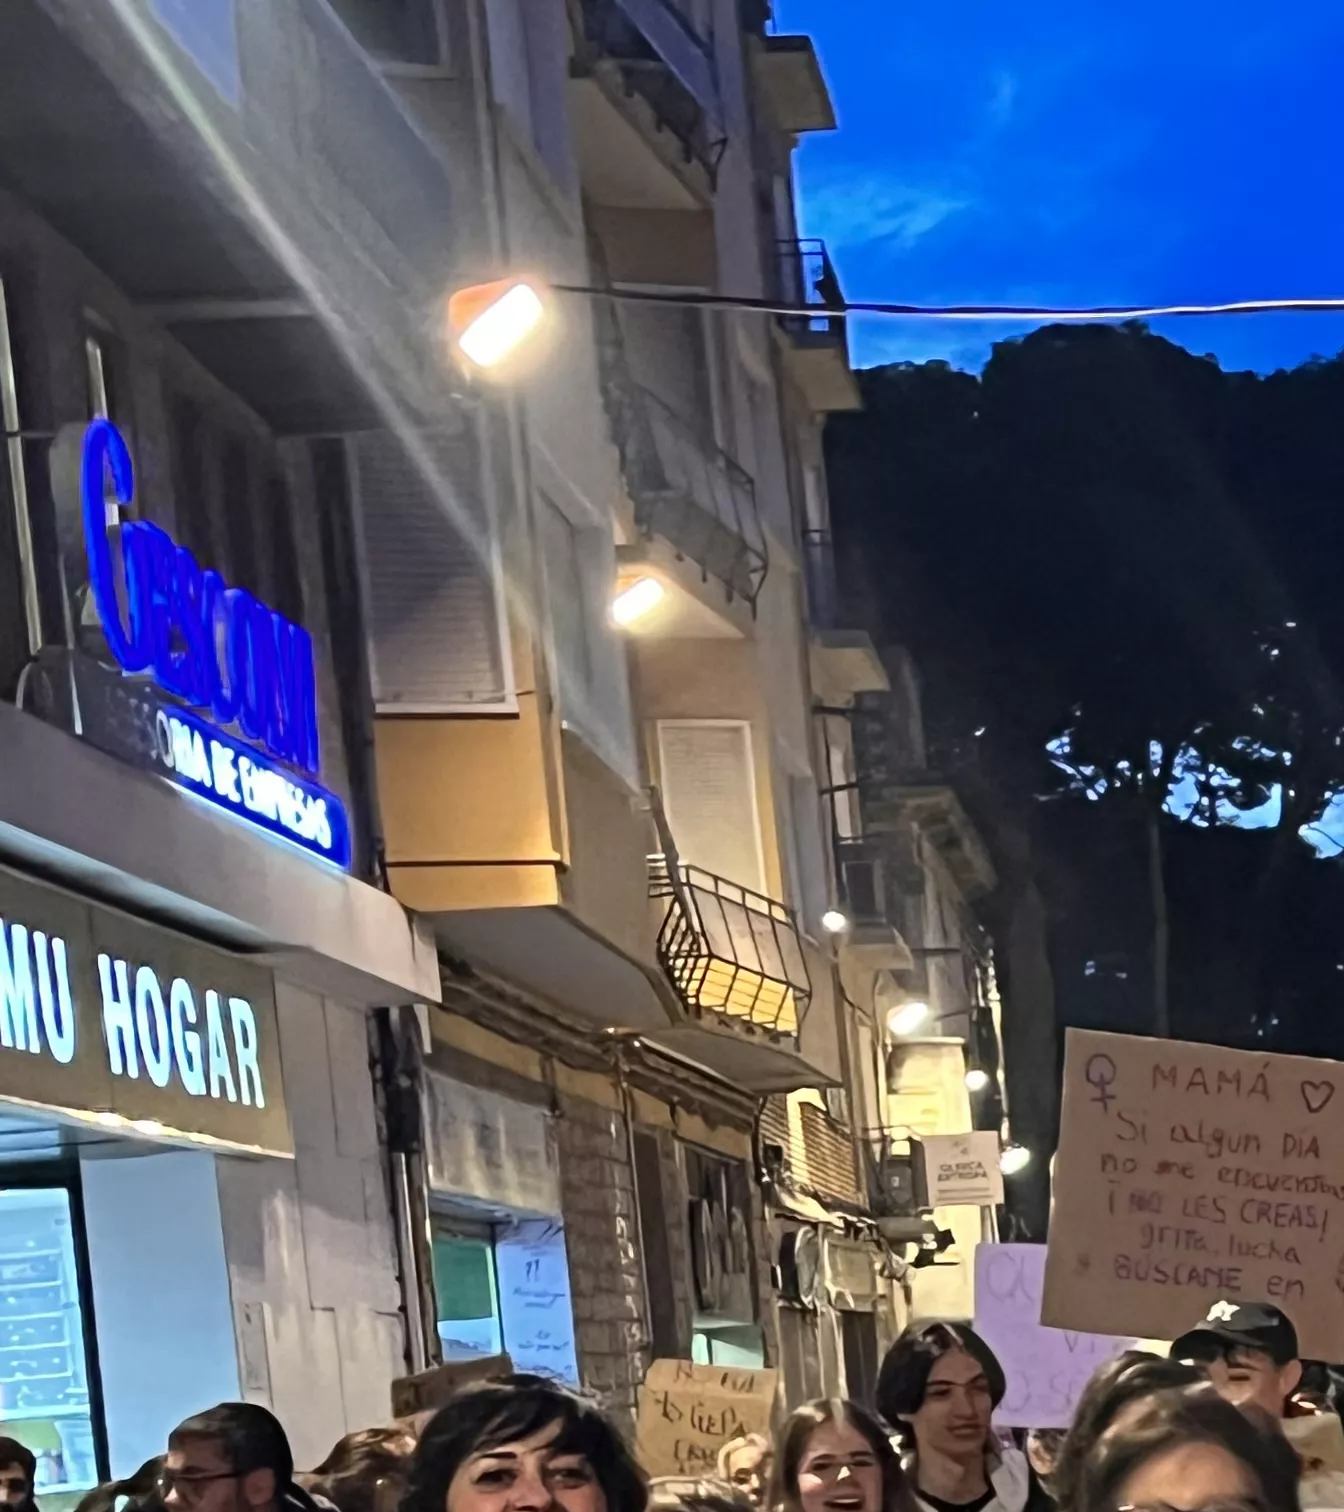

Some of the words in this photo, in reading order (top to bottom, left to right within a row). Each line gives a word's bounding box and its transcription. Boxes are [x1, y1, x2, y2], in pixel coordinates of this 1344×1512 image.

[97, 953, 266, 1109] HOGAR
[1151, 1061, 1271, 1102] MAMÁ
[1182, 1194, 1227, 1225] LES
[1229, 1233, 1302, 1266] lucha
